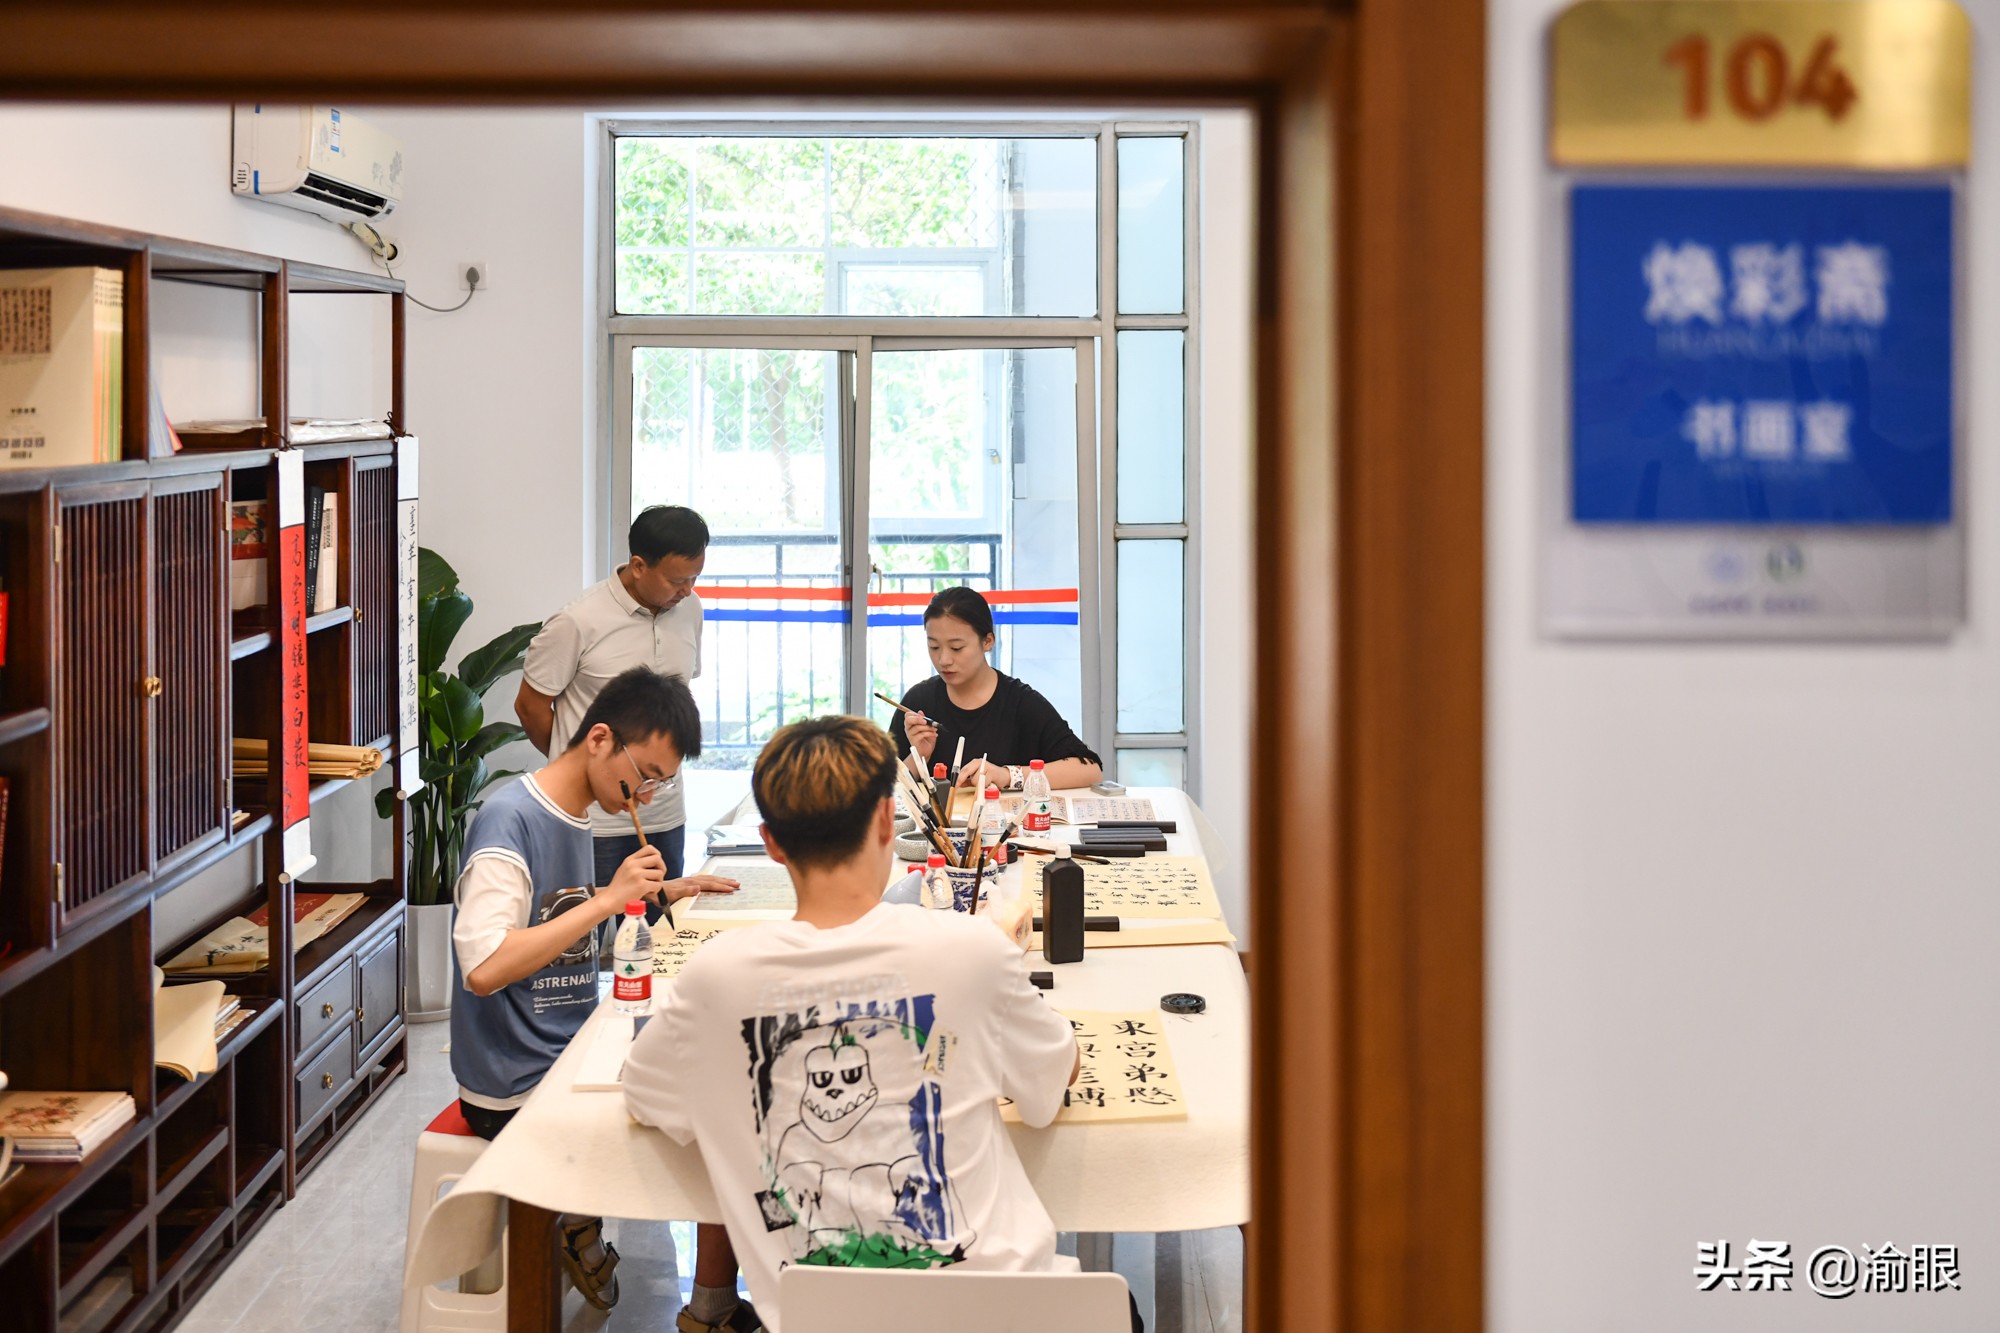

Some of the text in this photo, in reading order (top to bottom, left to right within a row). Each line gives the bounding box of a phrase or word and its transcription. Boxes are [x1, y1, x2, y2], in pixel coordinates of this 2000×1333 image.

[1663, 32, 1858, 125] 104
[1684, 399, 1855, 460] 书画室
